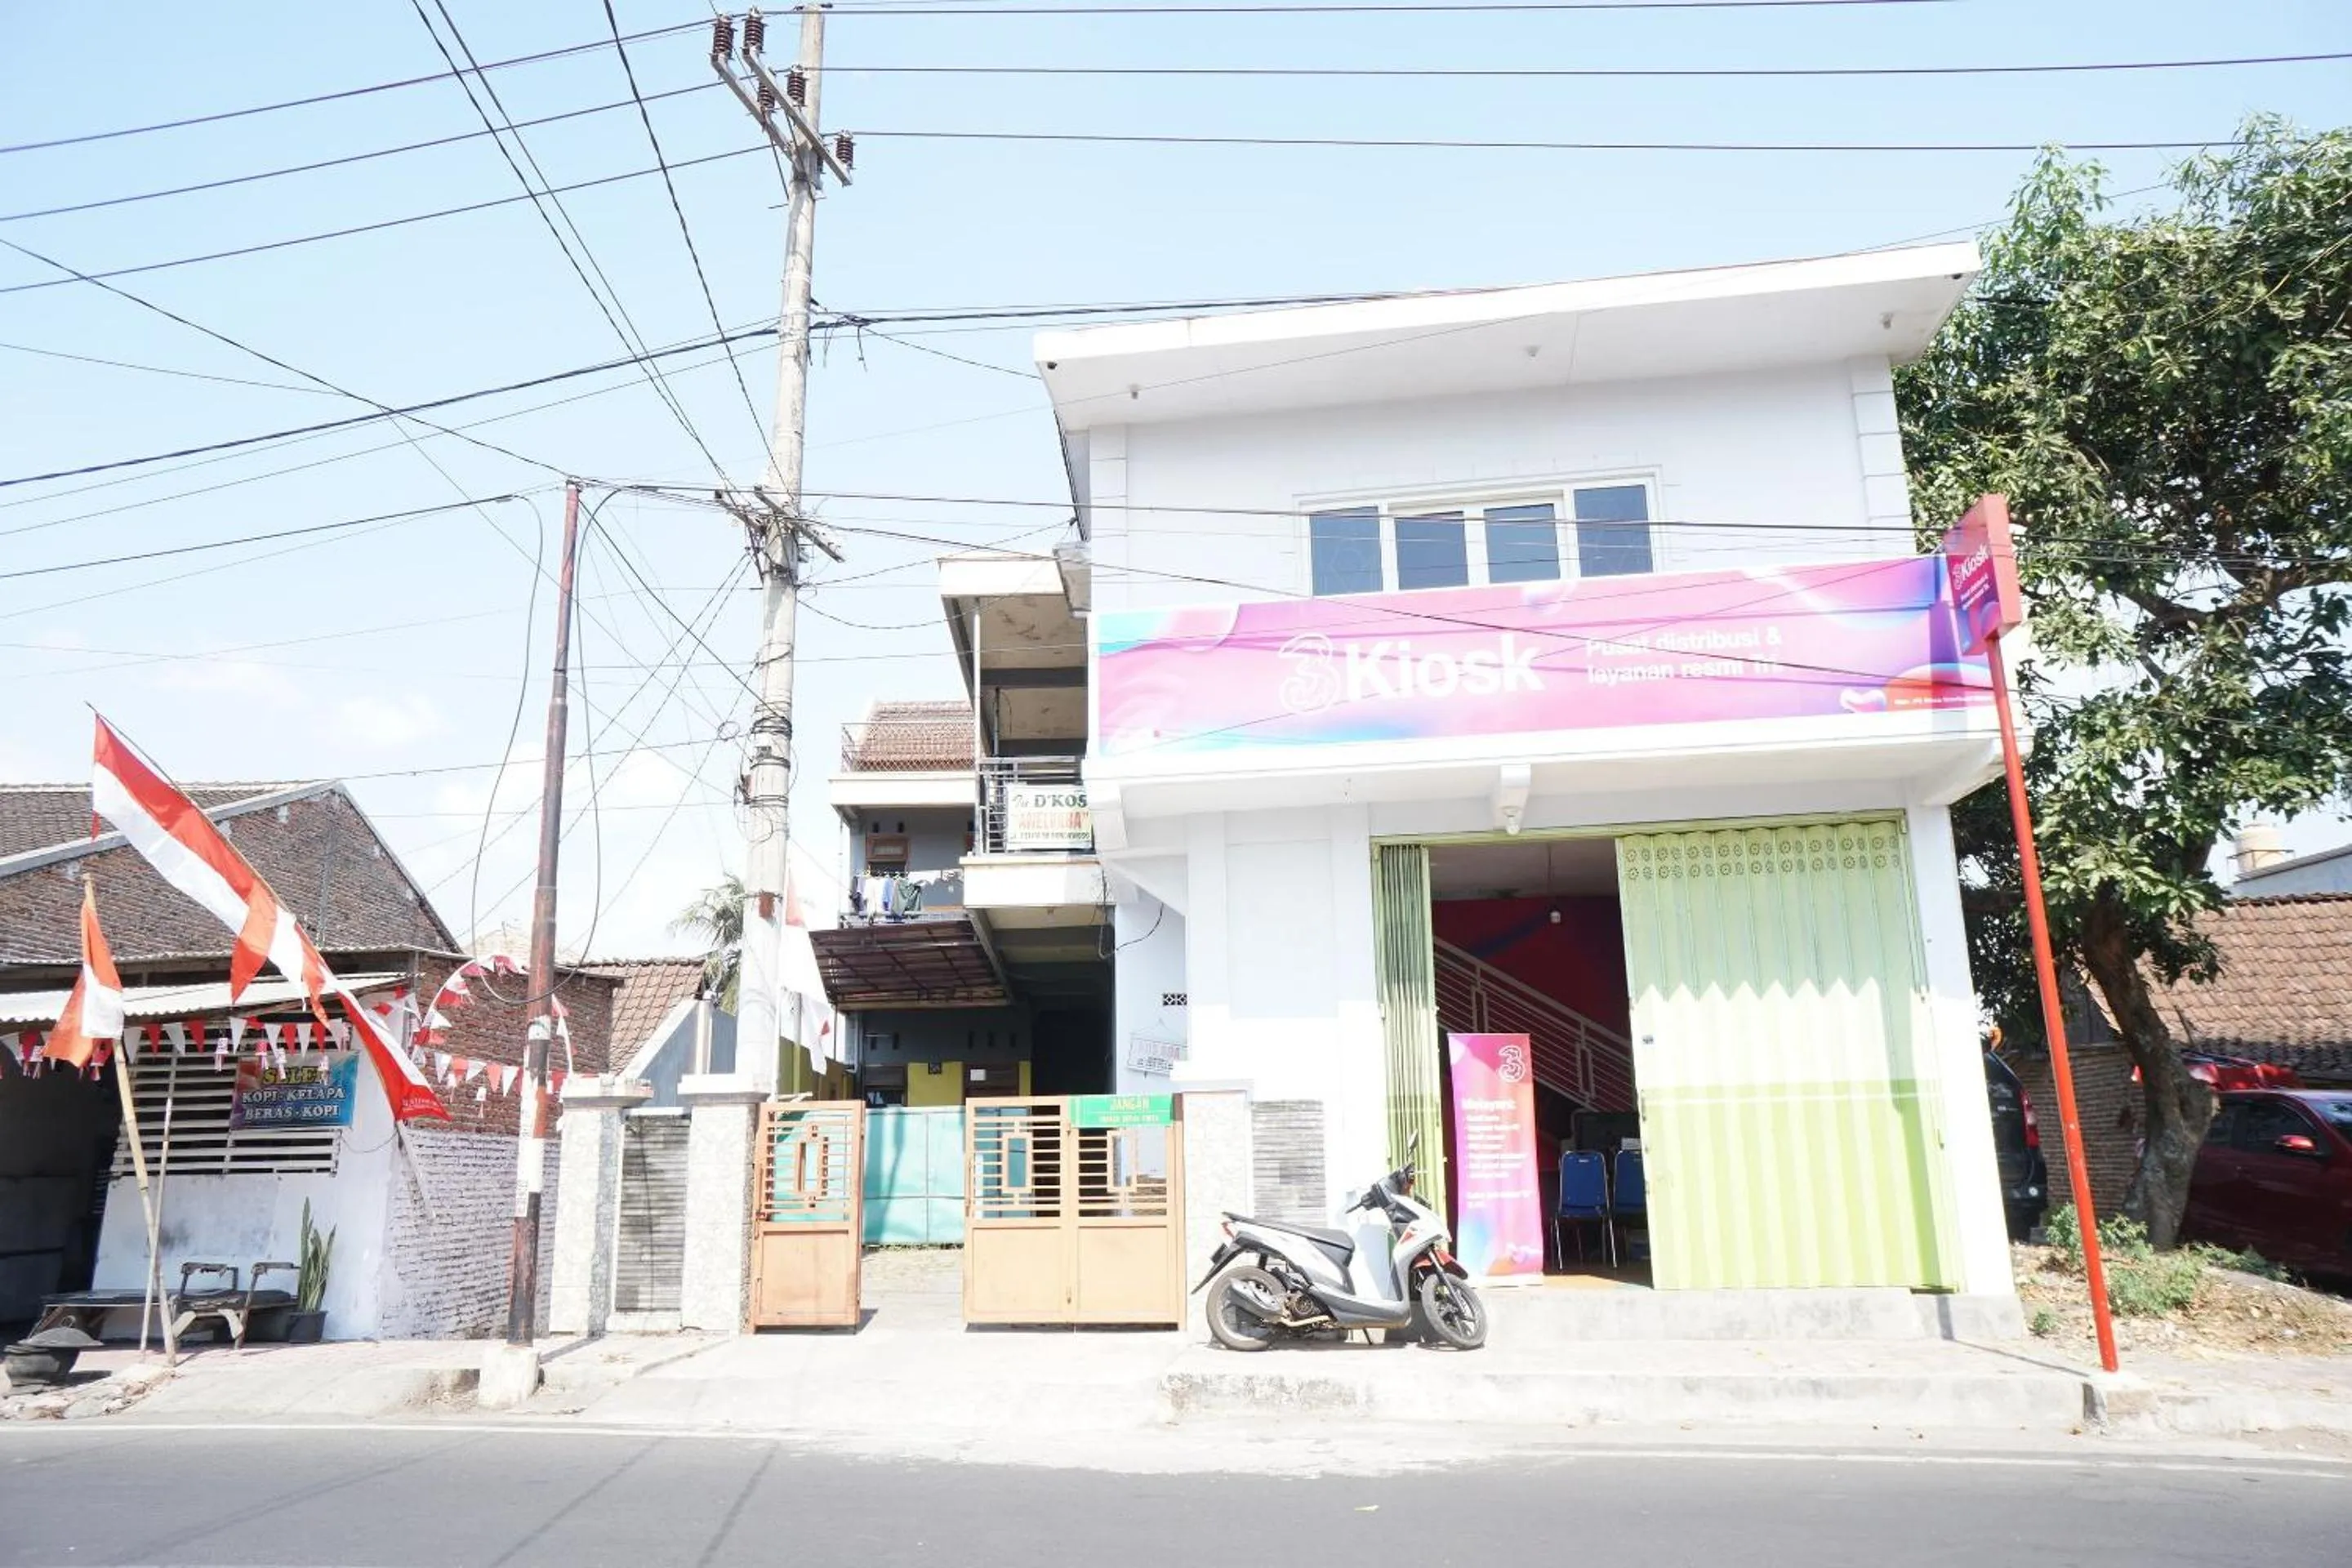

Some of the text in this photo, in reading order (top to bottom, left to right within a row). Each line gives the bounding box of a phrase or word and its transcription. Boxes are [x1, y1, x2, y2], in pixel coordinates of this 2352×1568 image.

[1960, 543, 1990, 581] Kiosk
[1655, 626, 1760, 650] distribusi
[1765, 626, 1783, 645] &
[1345, 633, 1547, 701] Kiosk
[1586, 663, 1675, 687] layanan
[1680, 659, 1744, 679] resmi
[242, 1089, 278, 1103] KOPI
[286, 1087, 345, 1102] KELAPA
[245, 1106, 292, 1120] BERAS
[302, 1105, 340, 1118] KOPI
